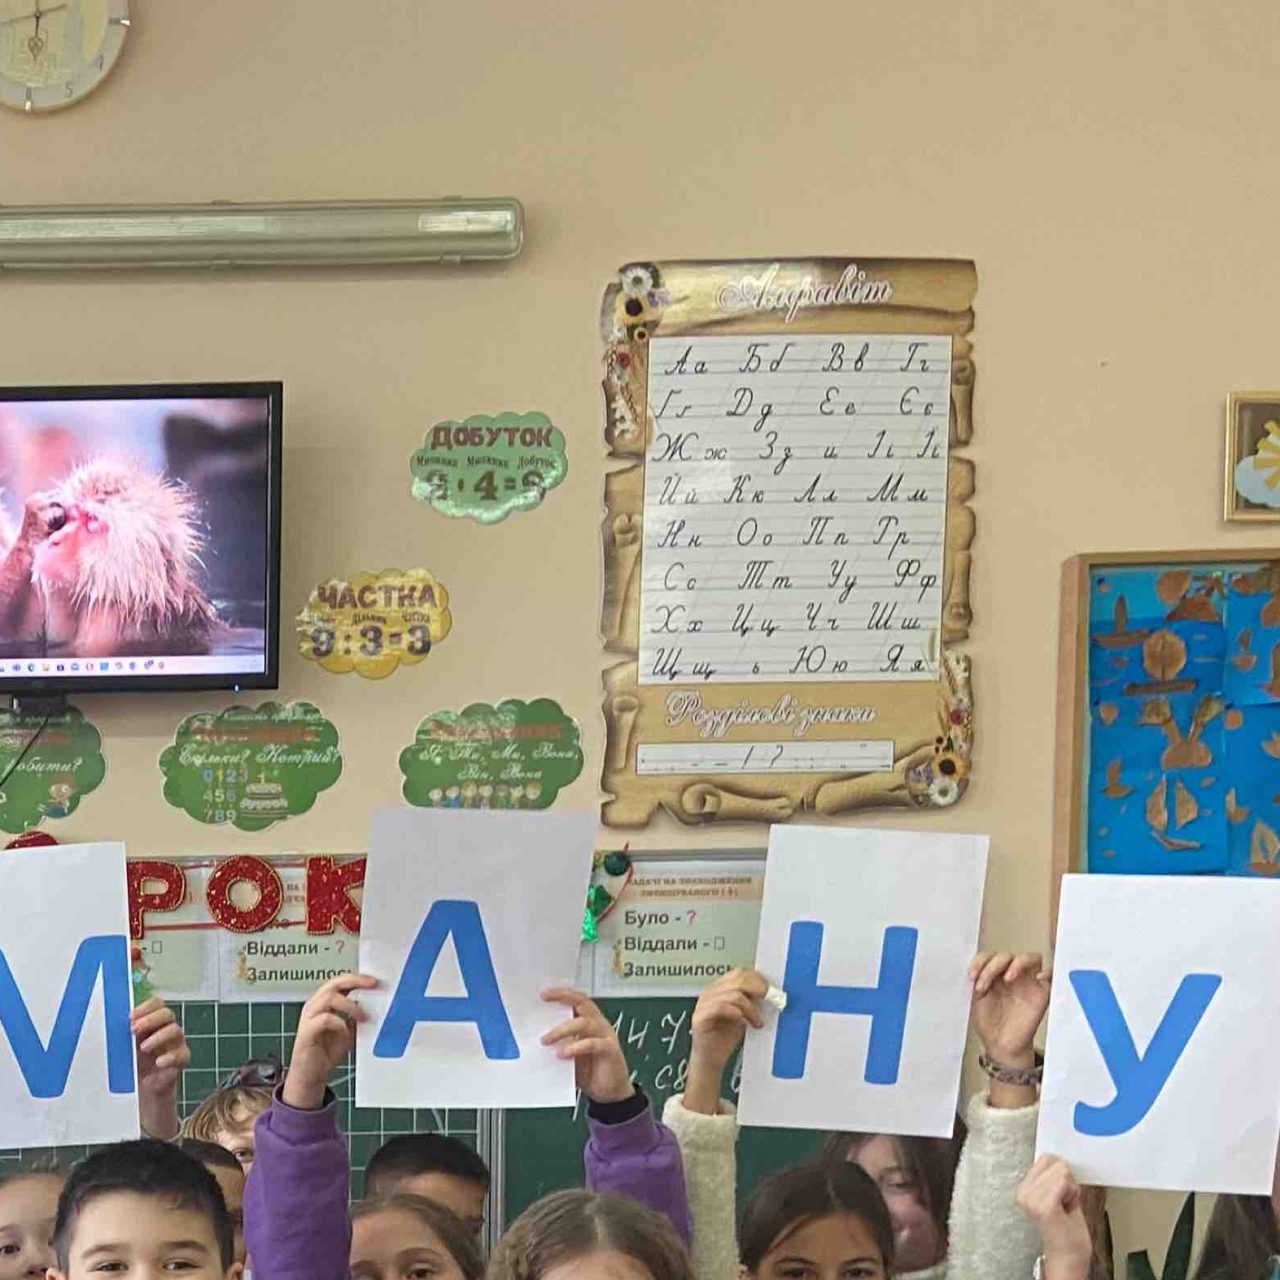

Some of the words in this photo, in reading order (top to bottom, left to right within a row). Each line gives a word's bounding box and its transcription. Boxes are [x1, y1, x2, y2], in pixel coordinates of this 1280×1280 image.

[431, 427, 553, 450] ДОБУТОК
[318, 584, 438, 609] ЧАСТКА
[624, 910, 669, 928] Було
[247, 942, 319, 957] Віддали
[624, 936, 698, 952] Віддали
